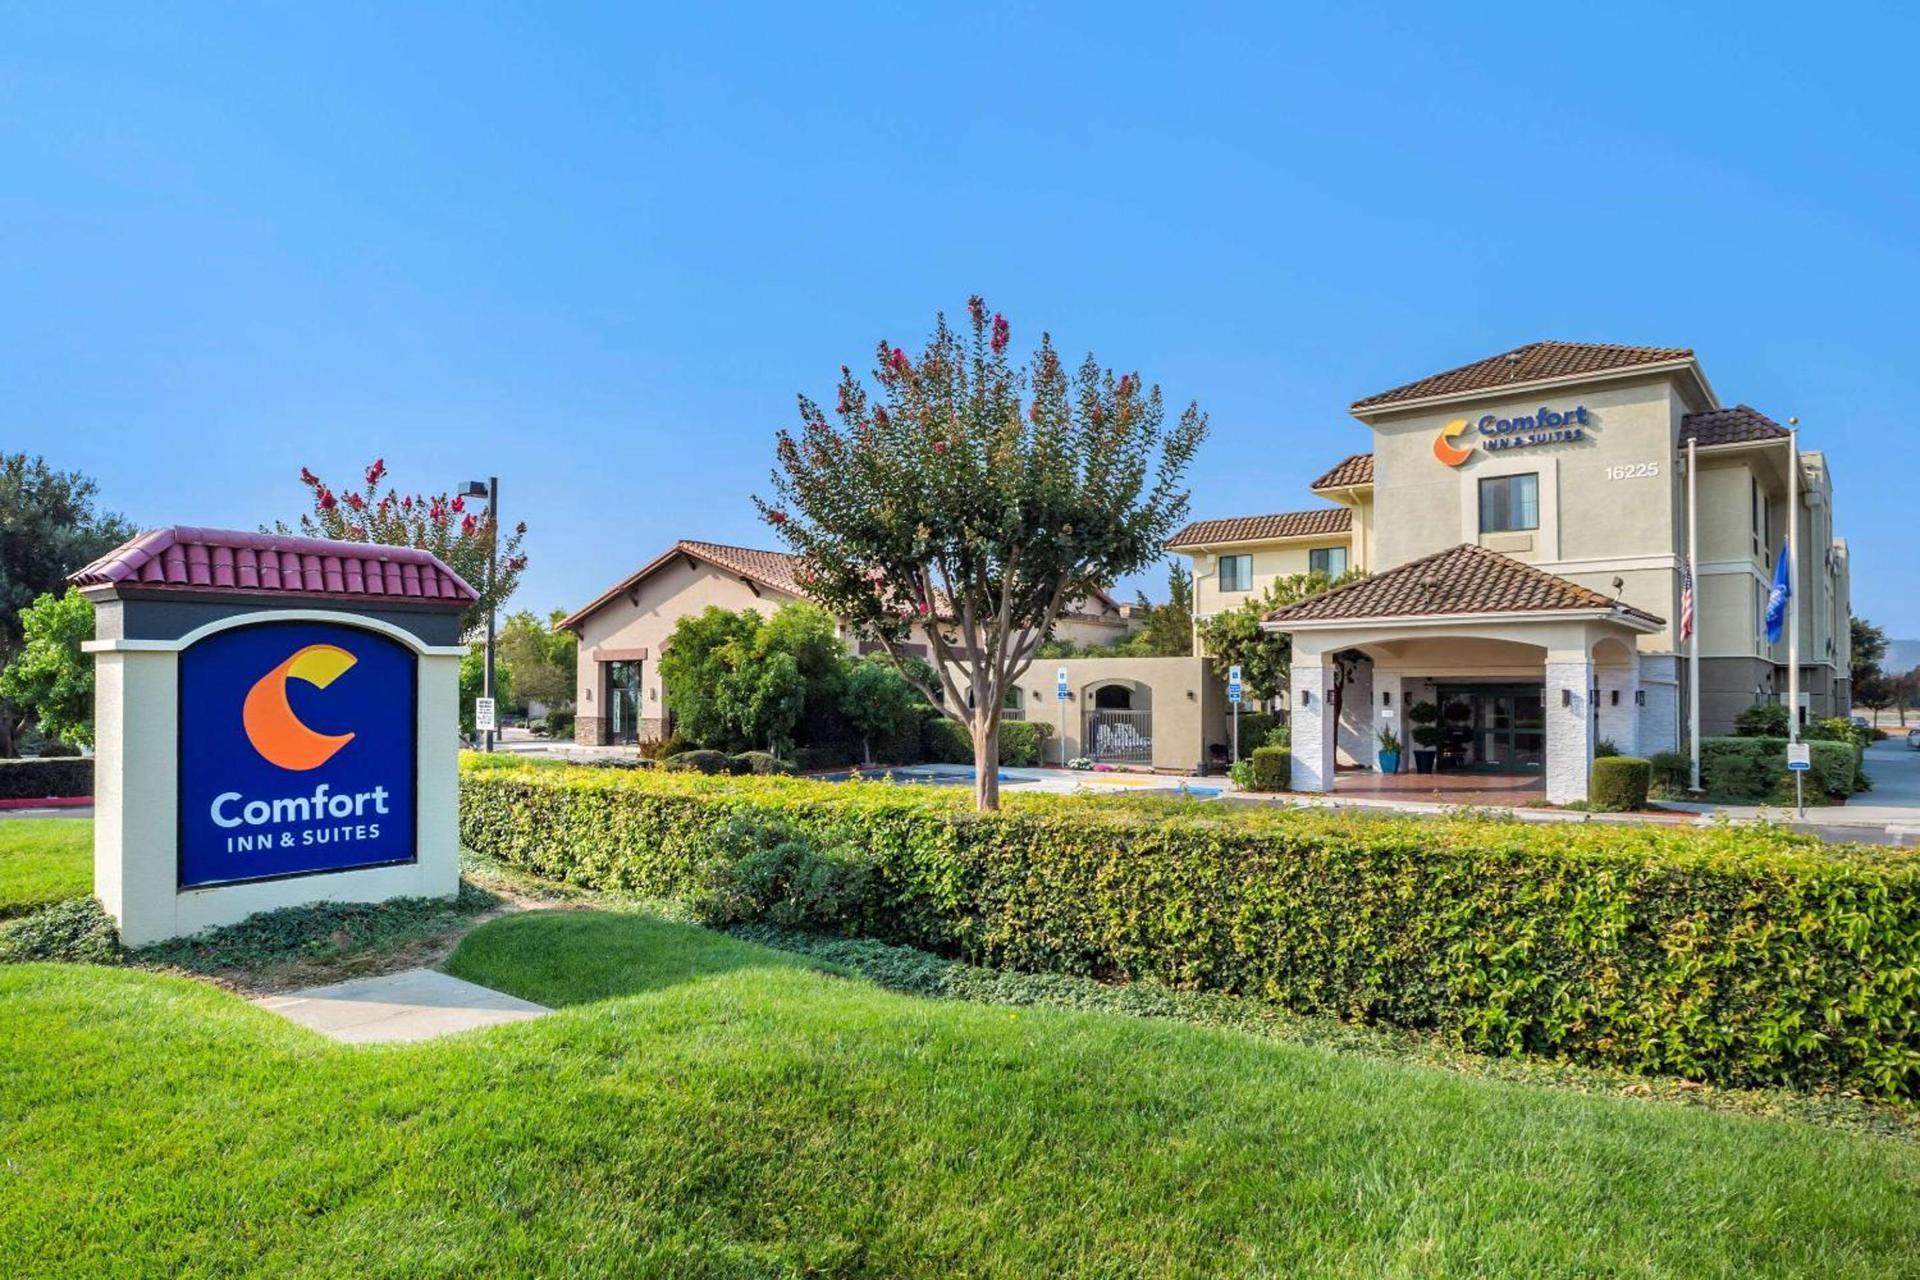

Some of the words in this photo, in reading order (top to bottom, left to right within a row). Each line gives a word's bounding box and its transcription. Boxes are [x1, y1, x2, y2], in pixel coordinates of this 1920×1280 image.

[1478, 406, 1588, 434] Comfort
[1483, 439, 1509, 450] INN
[1528, 428, 1583, 445] SUITES
[1606, 463, 1659, 480] 16225
[210, 783, 389, 828] Comfort
[227, 835, 272, 853] INN
[280, 832, 295, 847] &
[302, 824, 380, 845] SUITES
